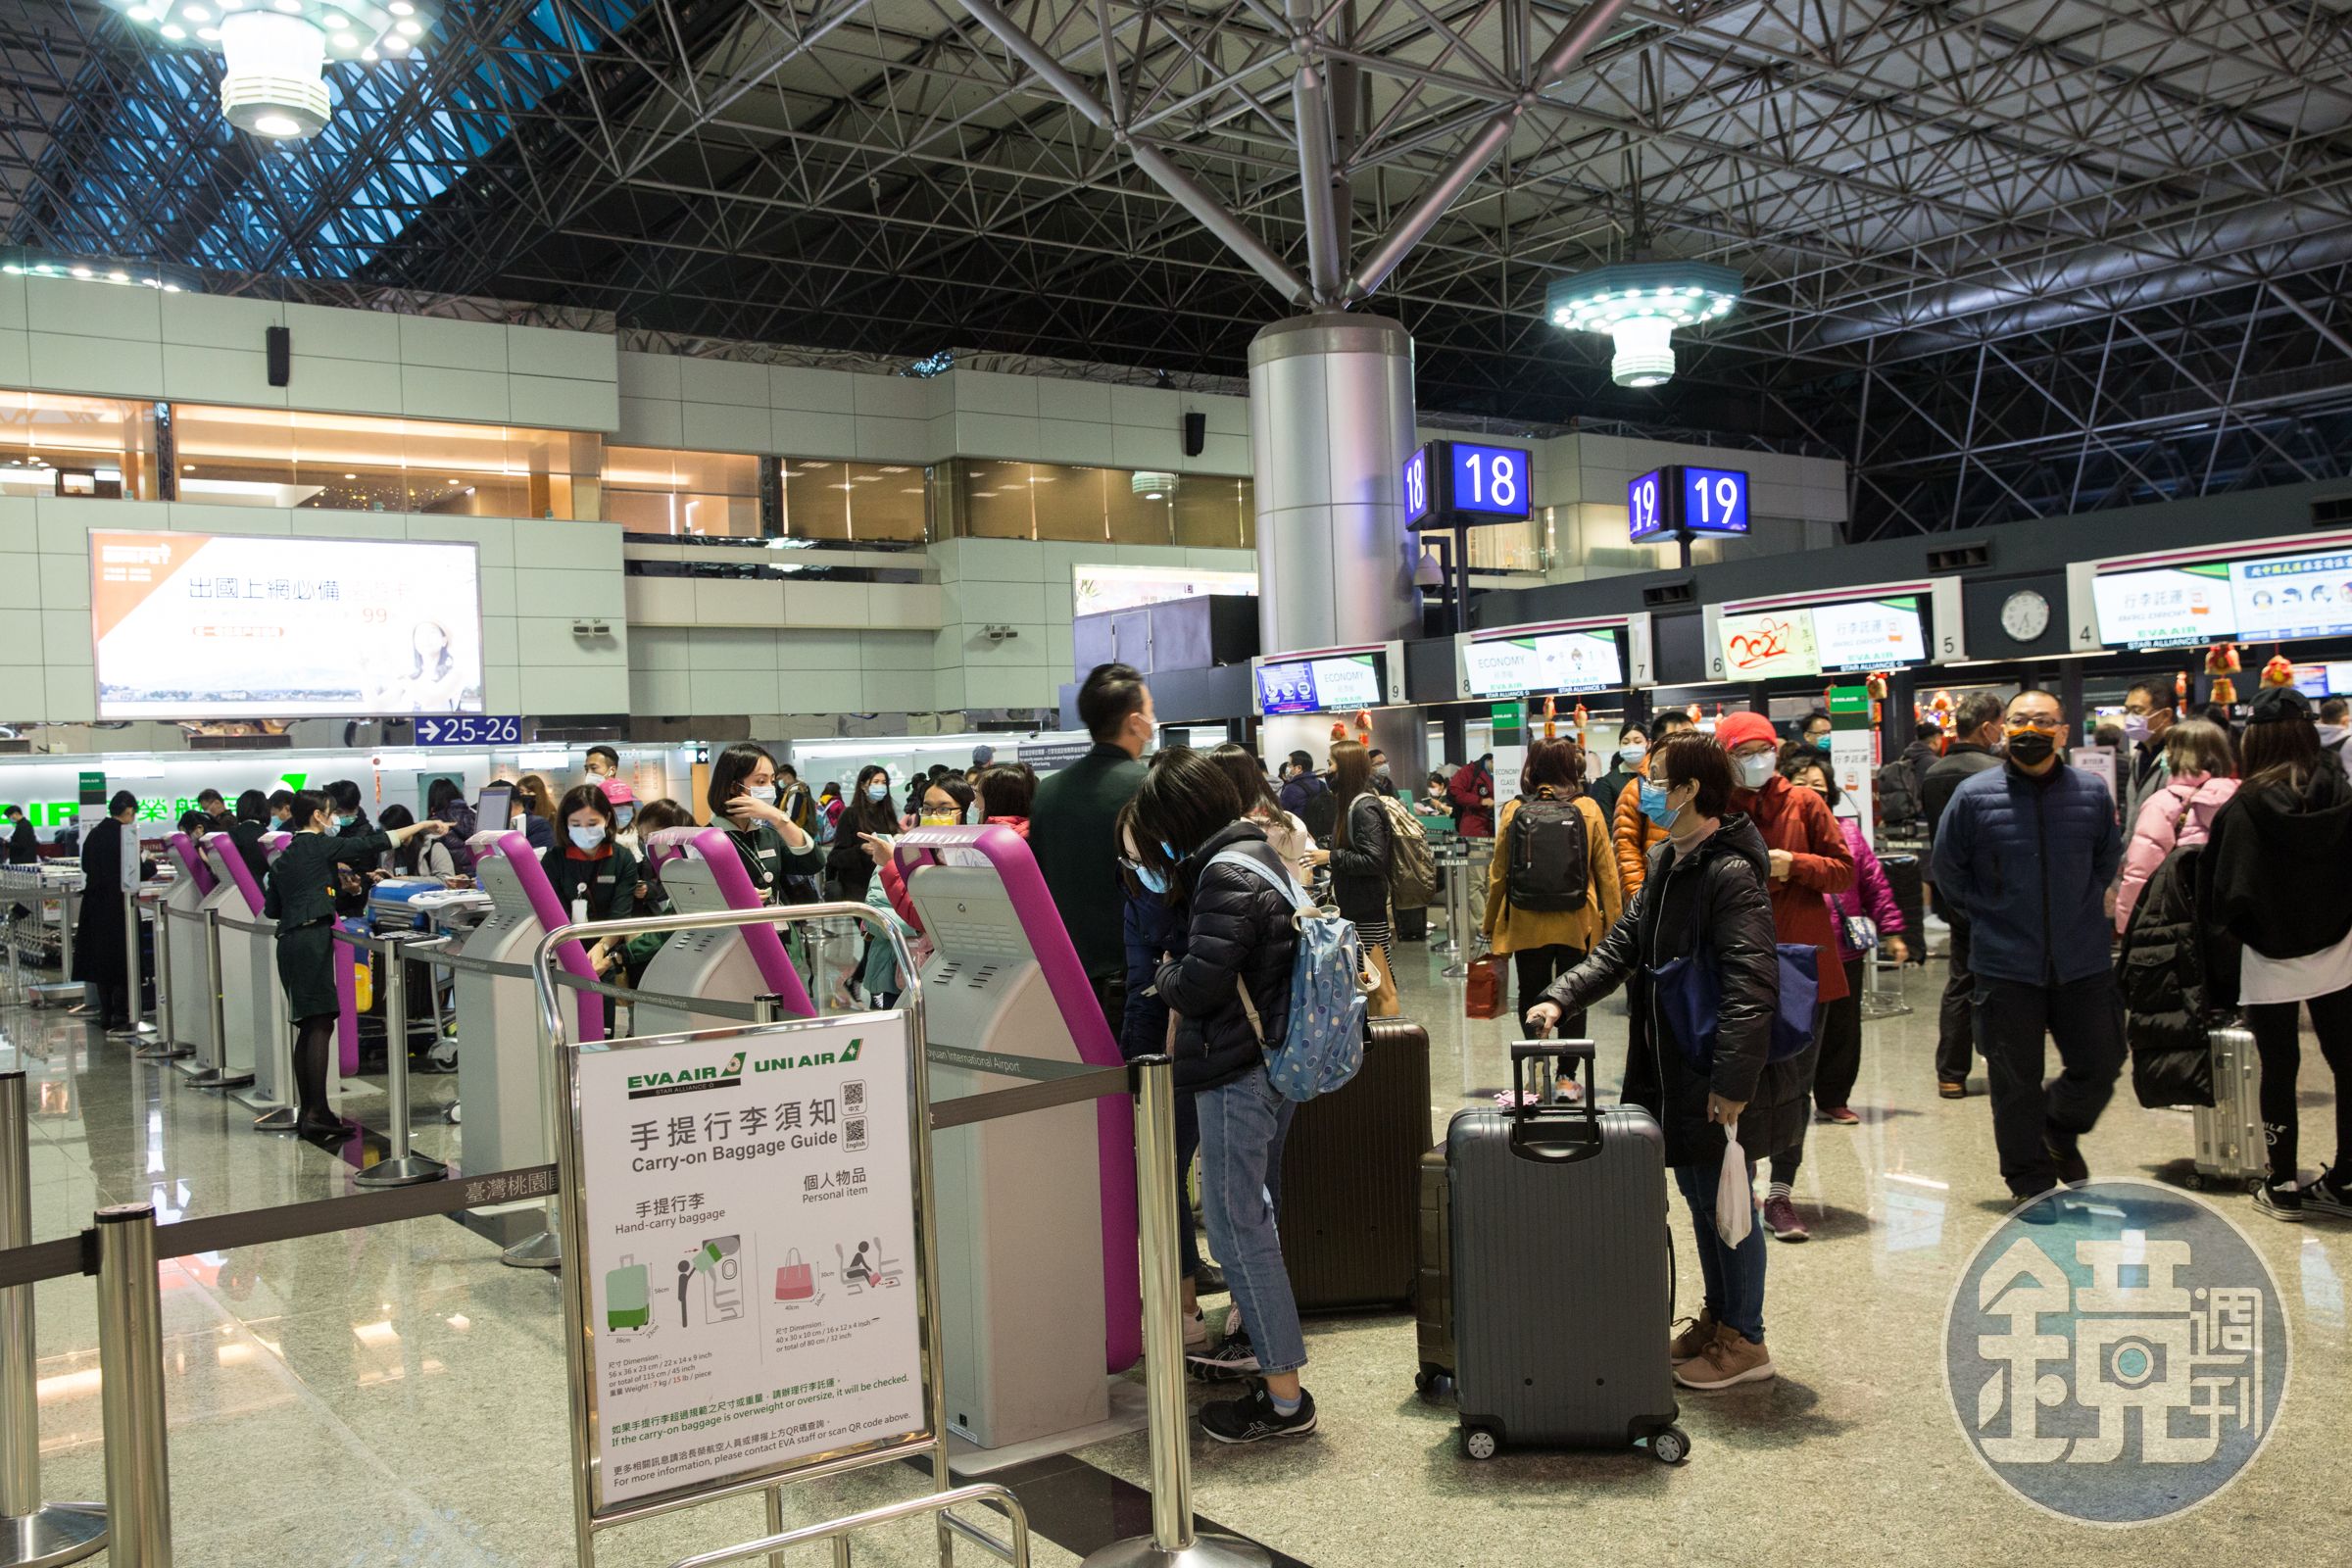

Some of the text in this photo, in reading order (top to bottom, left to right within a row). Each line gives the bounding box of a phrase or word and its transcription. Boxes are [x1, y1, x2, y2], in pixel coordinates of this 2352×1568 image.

[1407, 460, 1423, 513] 18
[1465, 454, 1515, 506] 18
[1633, 480, 1655, 530] 19
[1694, 476, 1738, 524] 19
[190, 576, 339, 600] 出國上網必備
[2080, 625, 2091, 643] 4
[2128, 636, 2200, 650] STAR ALLIANCE
[1944, 636, 1954, 653] 5
[1478, 656, 1525, 668] ECONOMY
[1638, 664, 1645, 678] 7
[1713, 659, 1722, 672] 6
[1324, 671, 1363, 683] ECONOMY
[1463, 679, 1470, 693] 8
[1392, 685, 1399, 698] 9
[443, 717, 517, 742] 25-26
[754, 1053, 835, 1073] UNI AIR
[948, 1051, 992, 1068] International
[994, 1055, 1020, 1074] Airport
[656, 1083, 707, 1096] STAR ALLIANCE
[848, 1104, 860, 1113] 中文
[630, 1098, 836, 1152] 手提行李須知
[632, 1130, 838, 1173] Carry-on Baggage Guide
[846, 1140, 866, 1150] English
[804, 1167, 866, 1193] 個人物品
[803, 1184, 868, 1203] Personal item
[635, 1192, 706, 1218] 手提行李
[615, 1207, 726, 1235] Hand-carry baggage
[789, 1321, 822, 1333] Dimension
[784, 1342, 799, 1350] total
[623, 1354, 659, 1366] Dimension
[617, 1376, 633, 1386] total
[624, 1383, 649, 1394] Weight
[694, 1370, 712, 1381] piece
[612, 1437, 620, 1447] If
[621, 1434, 637, 1446] the
[639, 1425, 679, 1442] carry-on
[681, 1415, 722, 1432] baggage
[723, 1413, 731, 1422] is
[733, 1400, 784, 1419] overweight
[797, 1391, 835, 1405] oversize,
[836, 1388, 843, 1396] it
[844, 1384, 859, 1396] will
[860, 1382, 871, 1392] be
[872, 1373, 909, 1389] checked.
[613, 1476, 629, 1488] For
[631, 1472, 656, 1483] more
[658, 1459, 712, 1477] information,
[714, 1450, 743, 1465] please
[744, 1443, 776, 1456] contact
[778, 1437, 796, 1448] EVA
[797, 1433, 816, 1445] staff
[828, 1426, 847, 1437] scan
[848, 1421, 861, 1432] QR
[862, 1417, 883, 1429] code
[884, 1411, 911, 1424] above.
